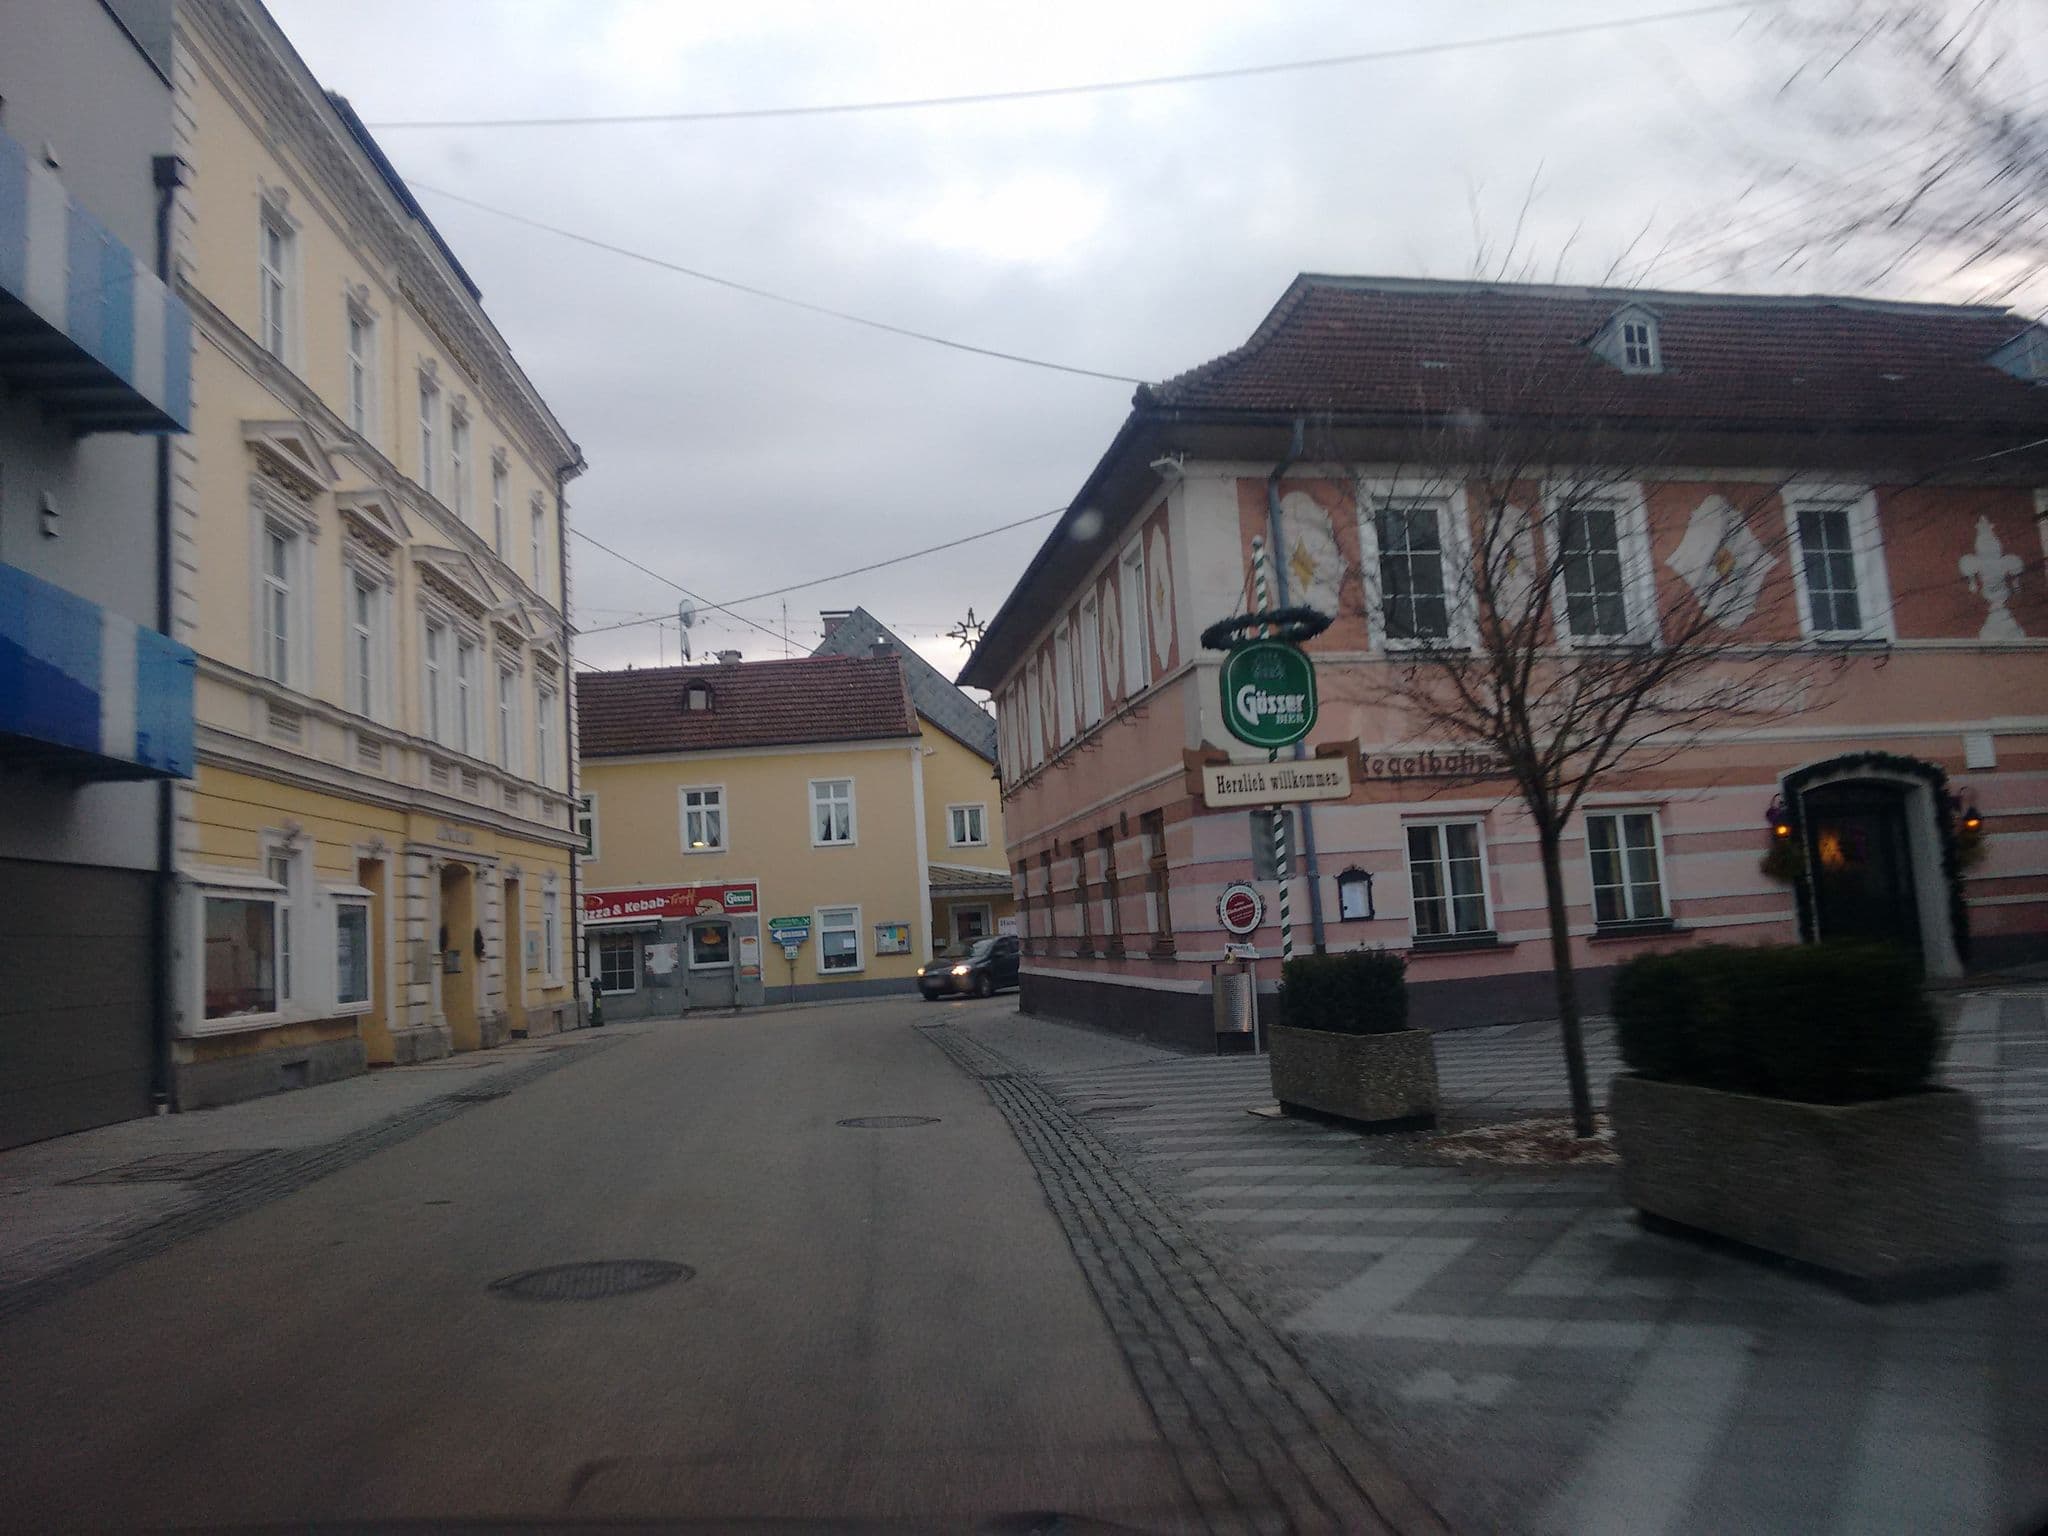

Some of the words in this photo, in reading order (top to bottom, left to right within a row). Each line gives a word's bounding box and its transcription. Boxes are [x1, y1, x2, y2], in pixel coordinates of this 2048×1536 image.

[1236, 684, 1306, 726] Gösser
[1275, 712, 1305, 725] BIER
[1215, 772, 1267, 794] Herzlich
[1270, 769, 1340, 791] willkommen
[612, 904, 622, 916] &
